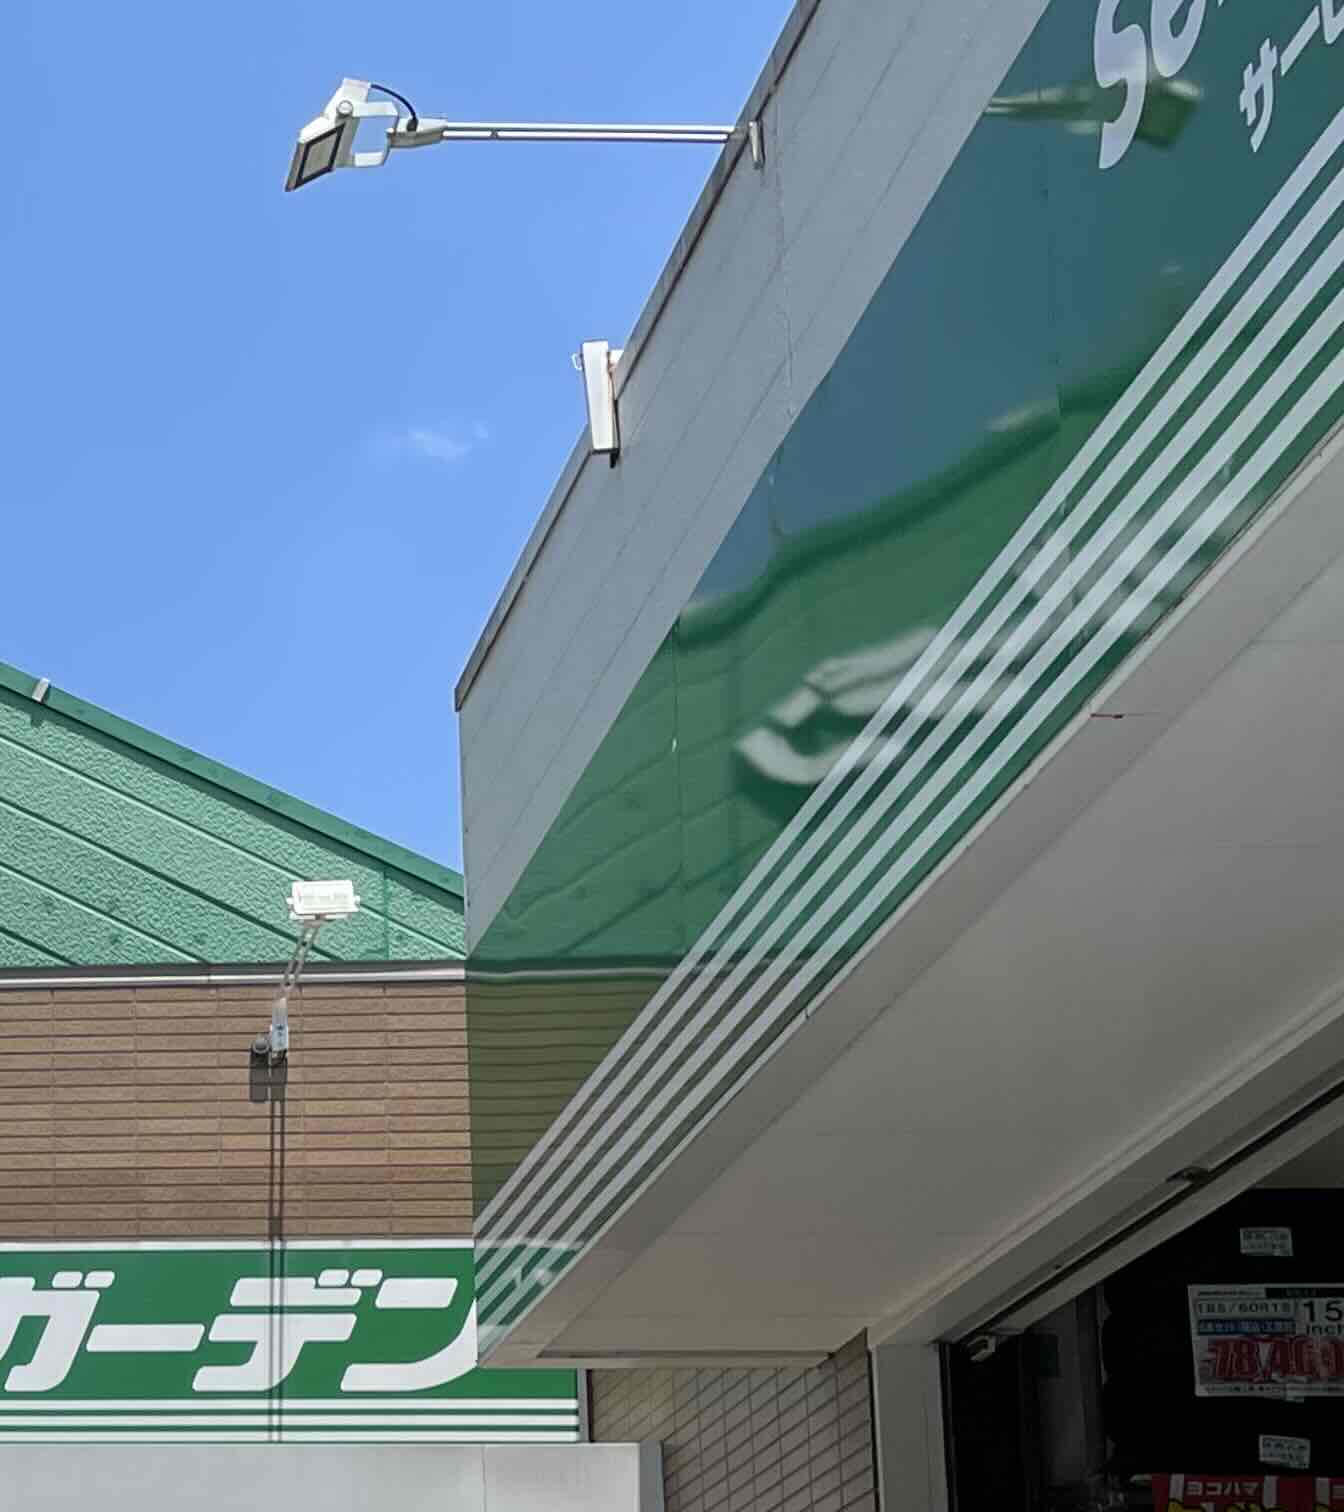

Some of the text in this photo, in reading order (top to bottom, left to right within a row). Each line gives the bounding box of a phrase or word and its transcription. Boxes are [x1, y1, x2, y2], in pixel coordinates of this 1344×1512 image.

[1303, 1299, 1344, 1323] 15
[1185, 1480, 1260, 1497] ヨコハマ
